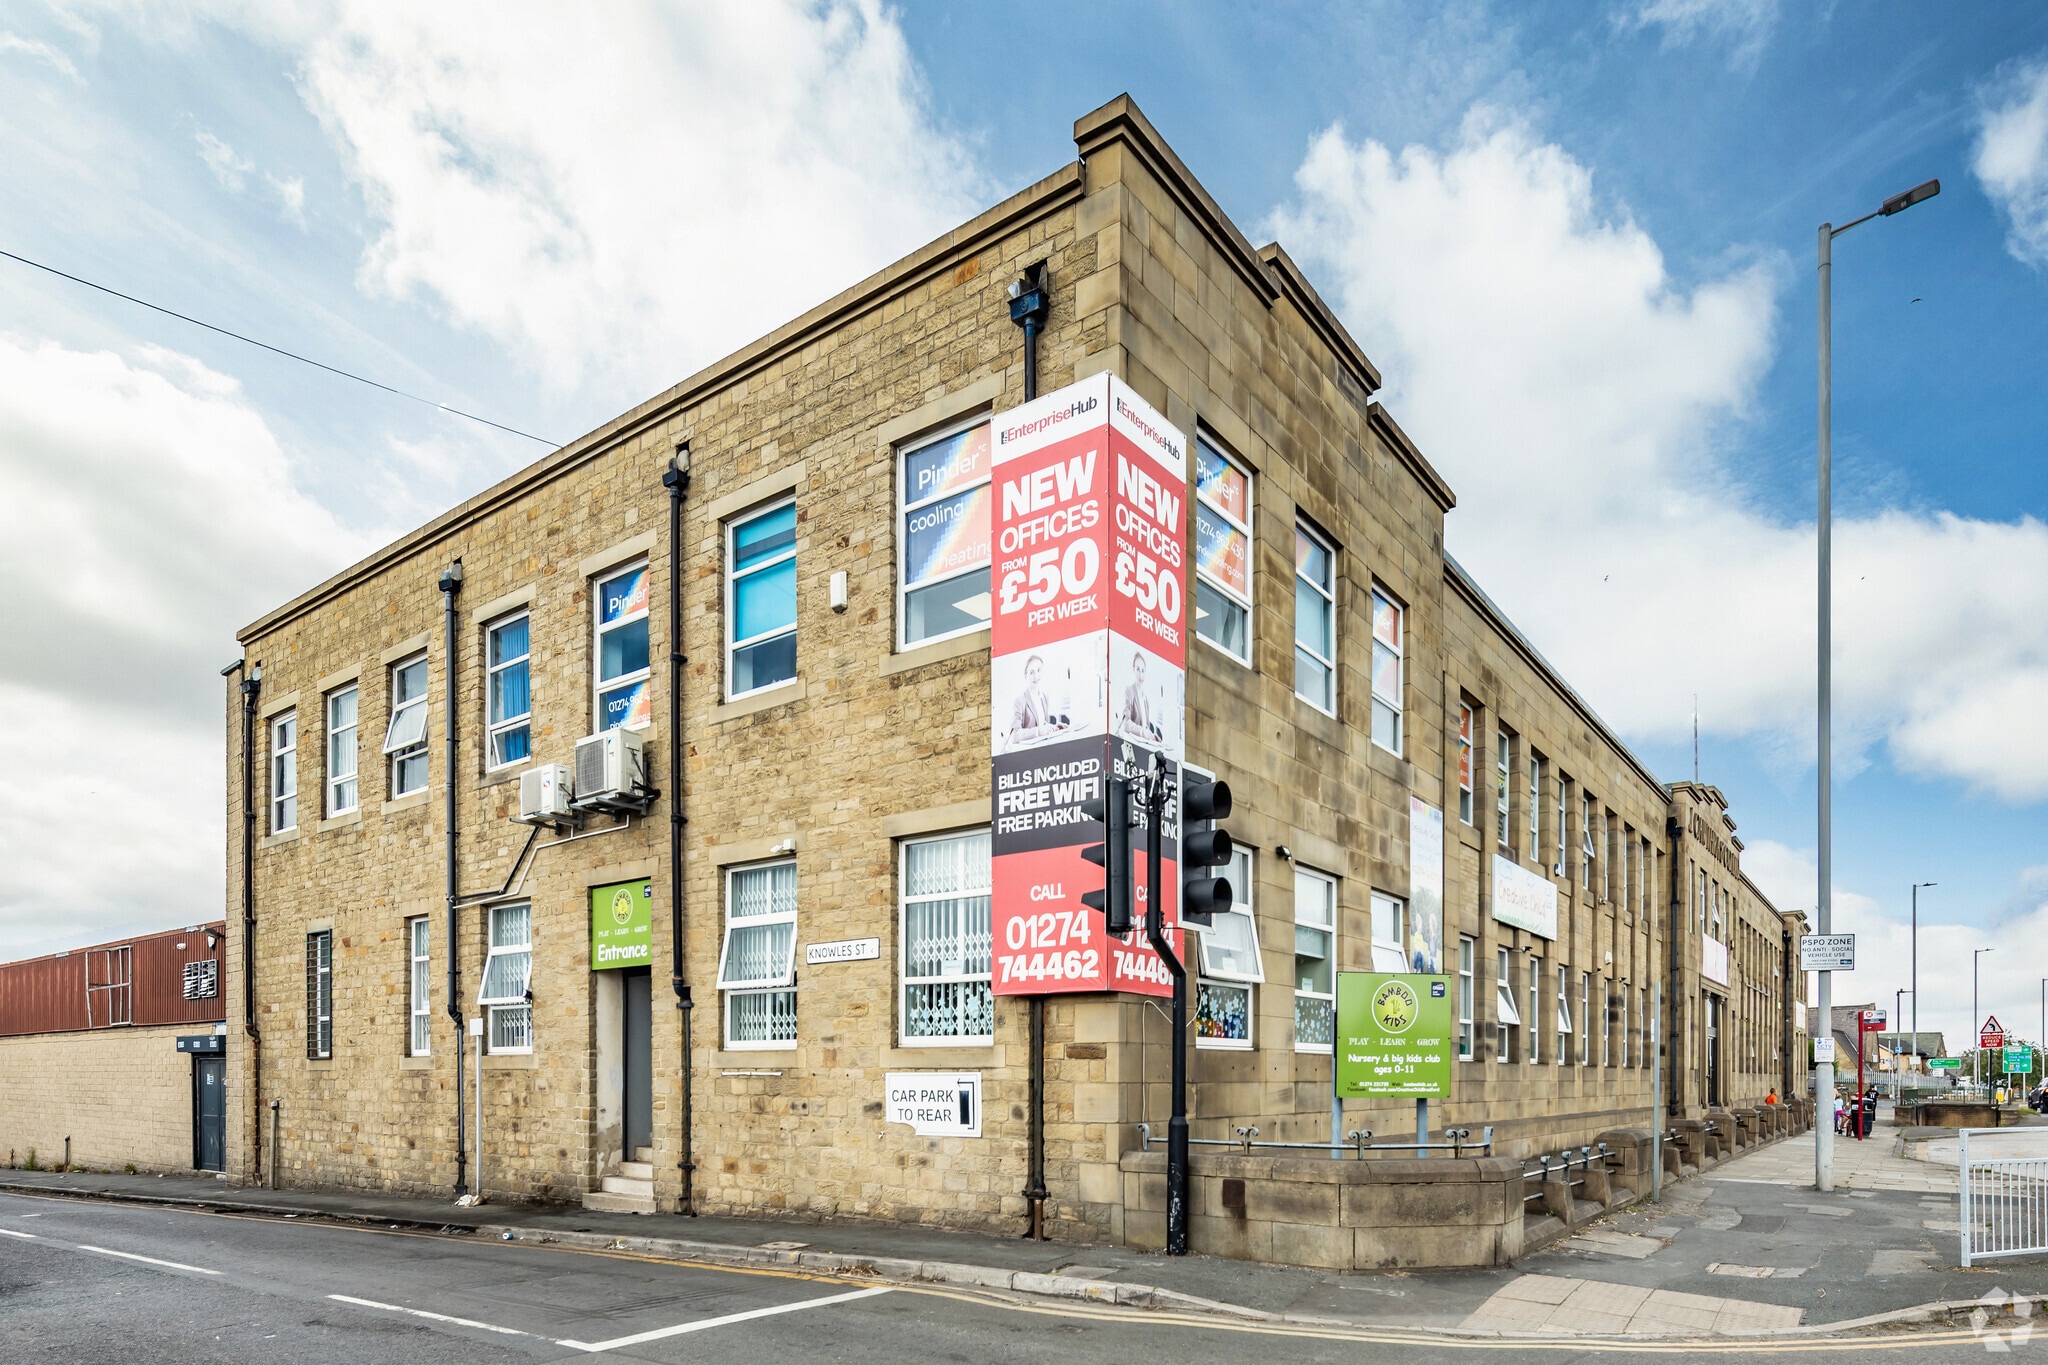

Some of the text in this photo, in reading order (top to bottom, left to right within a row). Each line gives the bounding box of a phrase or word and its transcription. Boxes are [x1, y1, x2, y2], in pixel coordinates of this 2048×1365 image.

[1007, 397, 1097, 442] EnterpriseHub
[1122, 402, 1180, 460] EnterpriseHub
[1003, 450, 1097, 522] NEW
[1118, 453, 1179, 534] NEW
[910, 502, 964, 534] cooling
[1000, 500, 1099, 553] OFFICES
[1116, 503, 1180, 568] OFFICES
[1116, 536, 1136, 558] FROM
[1230, 543, 1244, 560] 430
[1000, 538, 1100, 615] £50
[1002, 556, 1027, 574] FROM
[1115, 551, 1180, 624] £50
[1028, 594, 1098, 628] PER WEEK
[1136, 607, 1179, 646] PER WEEK
[608, 698, 629, 712] 01274
[999, 758, 1100, 790] BILLS INCLUDED
[998, 784, 1050, 814] FREE
[1052, 776, 1099, 806] WIFI
[998, 814, 1033, 834] FREE
[1030, 883, 1066, 902] CALL
[1006, 910, 1091, 950] 01274
[598, 944, 648, 962] Entrance
[808, 944, 852, 960] KNOWLES
[855, 944, 866, 956] ST
[998, 949, 1099, 983] 744462
[1114, 950, 1174, 986] 74446
[1378, 986, 1412, 1006] BAMBOO
[1383, 1014, 1406, 1027] KIDS
[1348, 1038, 1369, 1046] PLAY
[1380, 1038, 1406, 1046] LEARN
[1416, 1038, 1440, 1046] GROW
[1348, 1054, 1440, 1064] Nursery & big kids club
[1374, 1065, 1414, 1075] ages 0-11
[892, 1090, 954, 1103] CAR PARK
[898, 1108, 952, 1122] TO REAR
